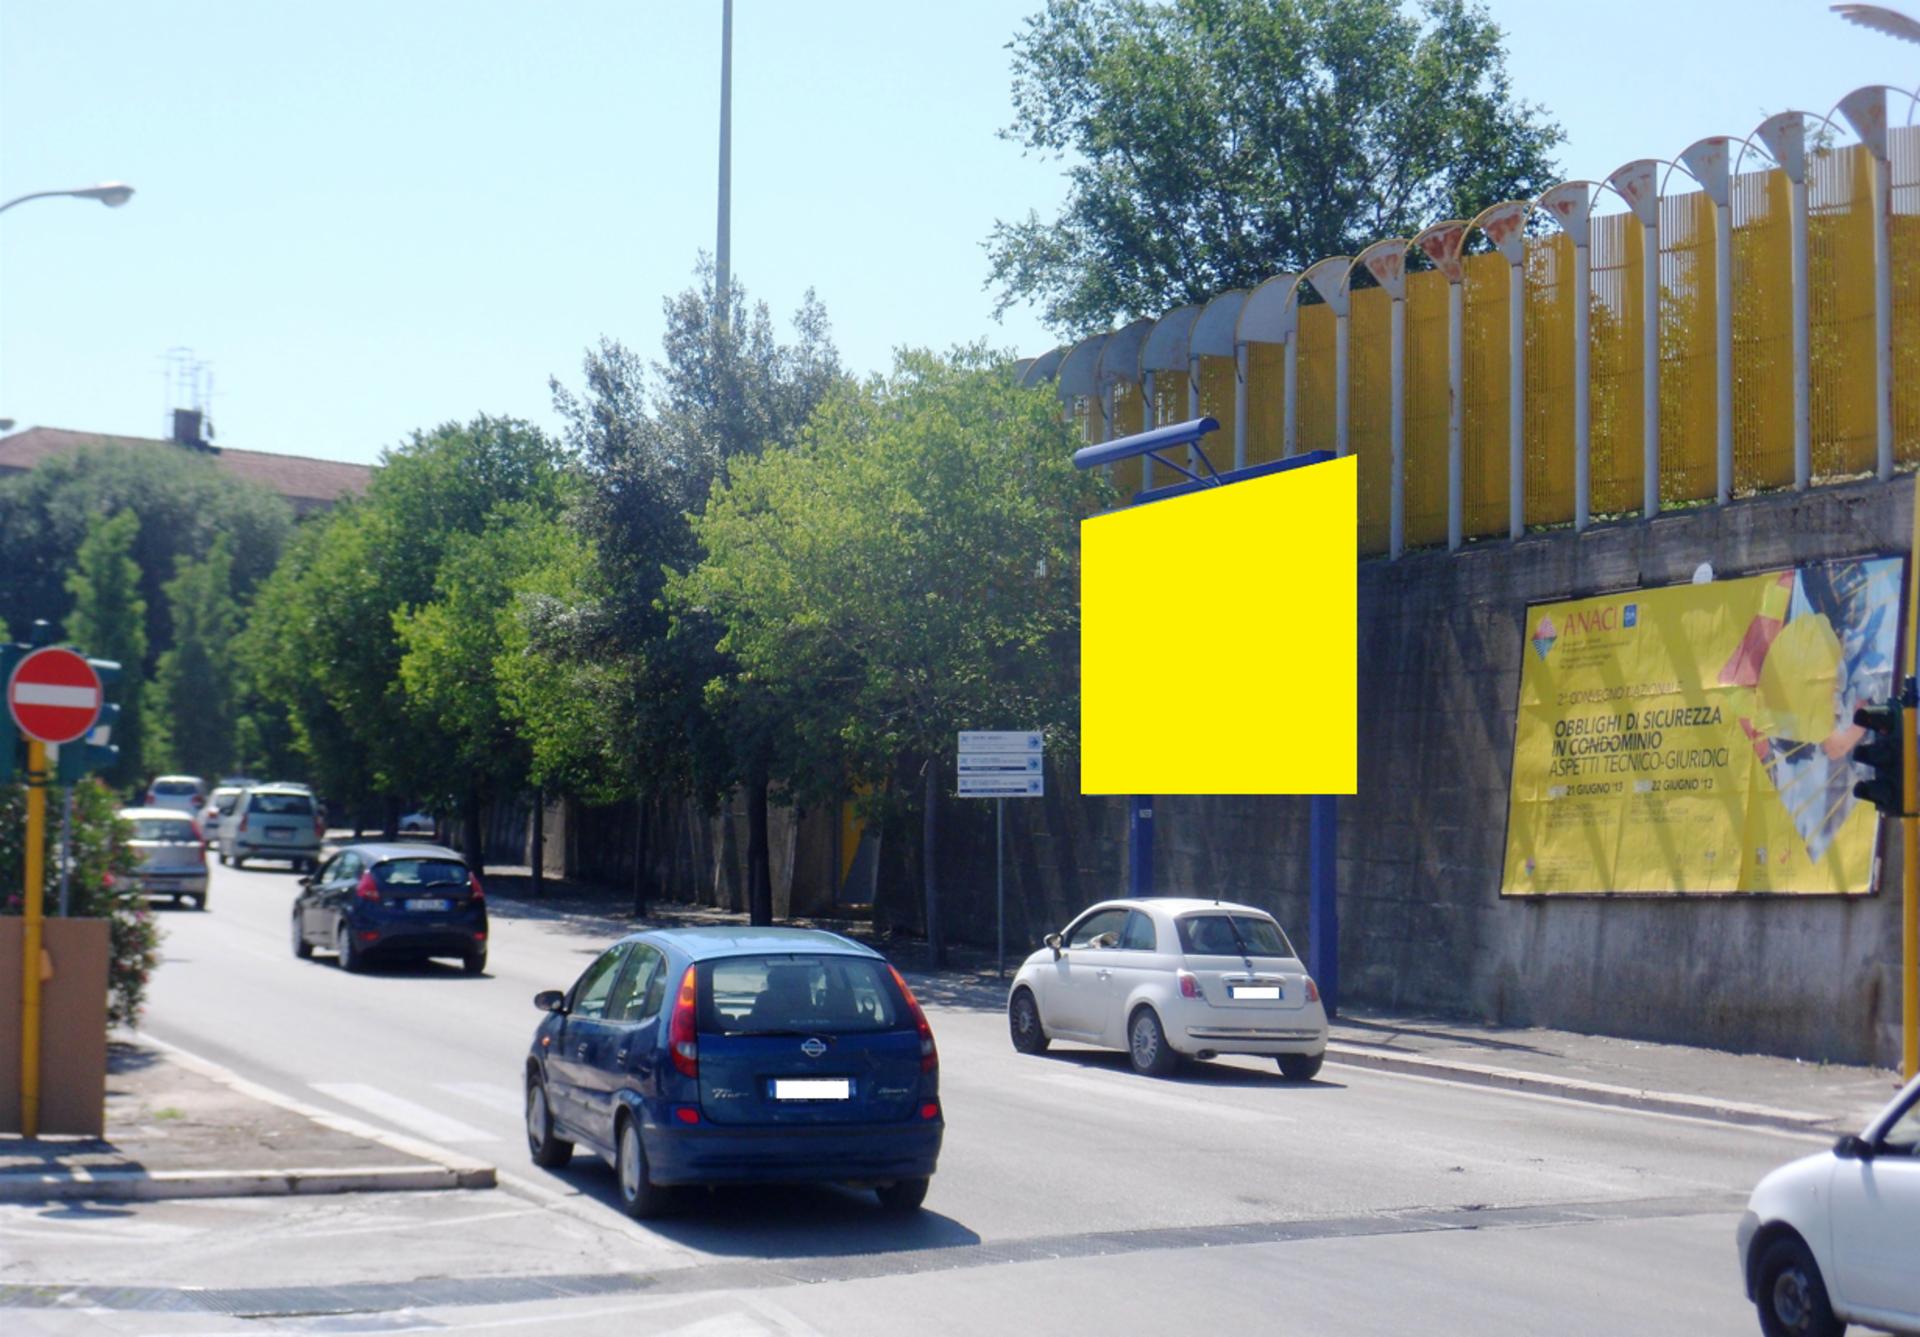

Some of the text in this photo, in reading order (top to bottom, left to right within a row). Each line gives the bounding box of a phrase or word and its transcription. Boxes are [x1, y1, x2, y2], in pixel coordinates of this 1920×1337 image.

[1563, 606, 1618, 636] ANACI
[1555, 706, 1722, 738] OBBLIGHI DI SICUREZZA
[1552, 731, 1663, 757] IN CONDOMINIO
[1549, 748, 1729, 777] ASPETTI TECNICO-GIURIDICI
[1566, 784, 1576, 796] 21
[1577, 782, 1610, 795] GIUGNO
[1651, 780, 1662, 792] 22
[1663, 779, 1699, 792] GIUGNO
